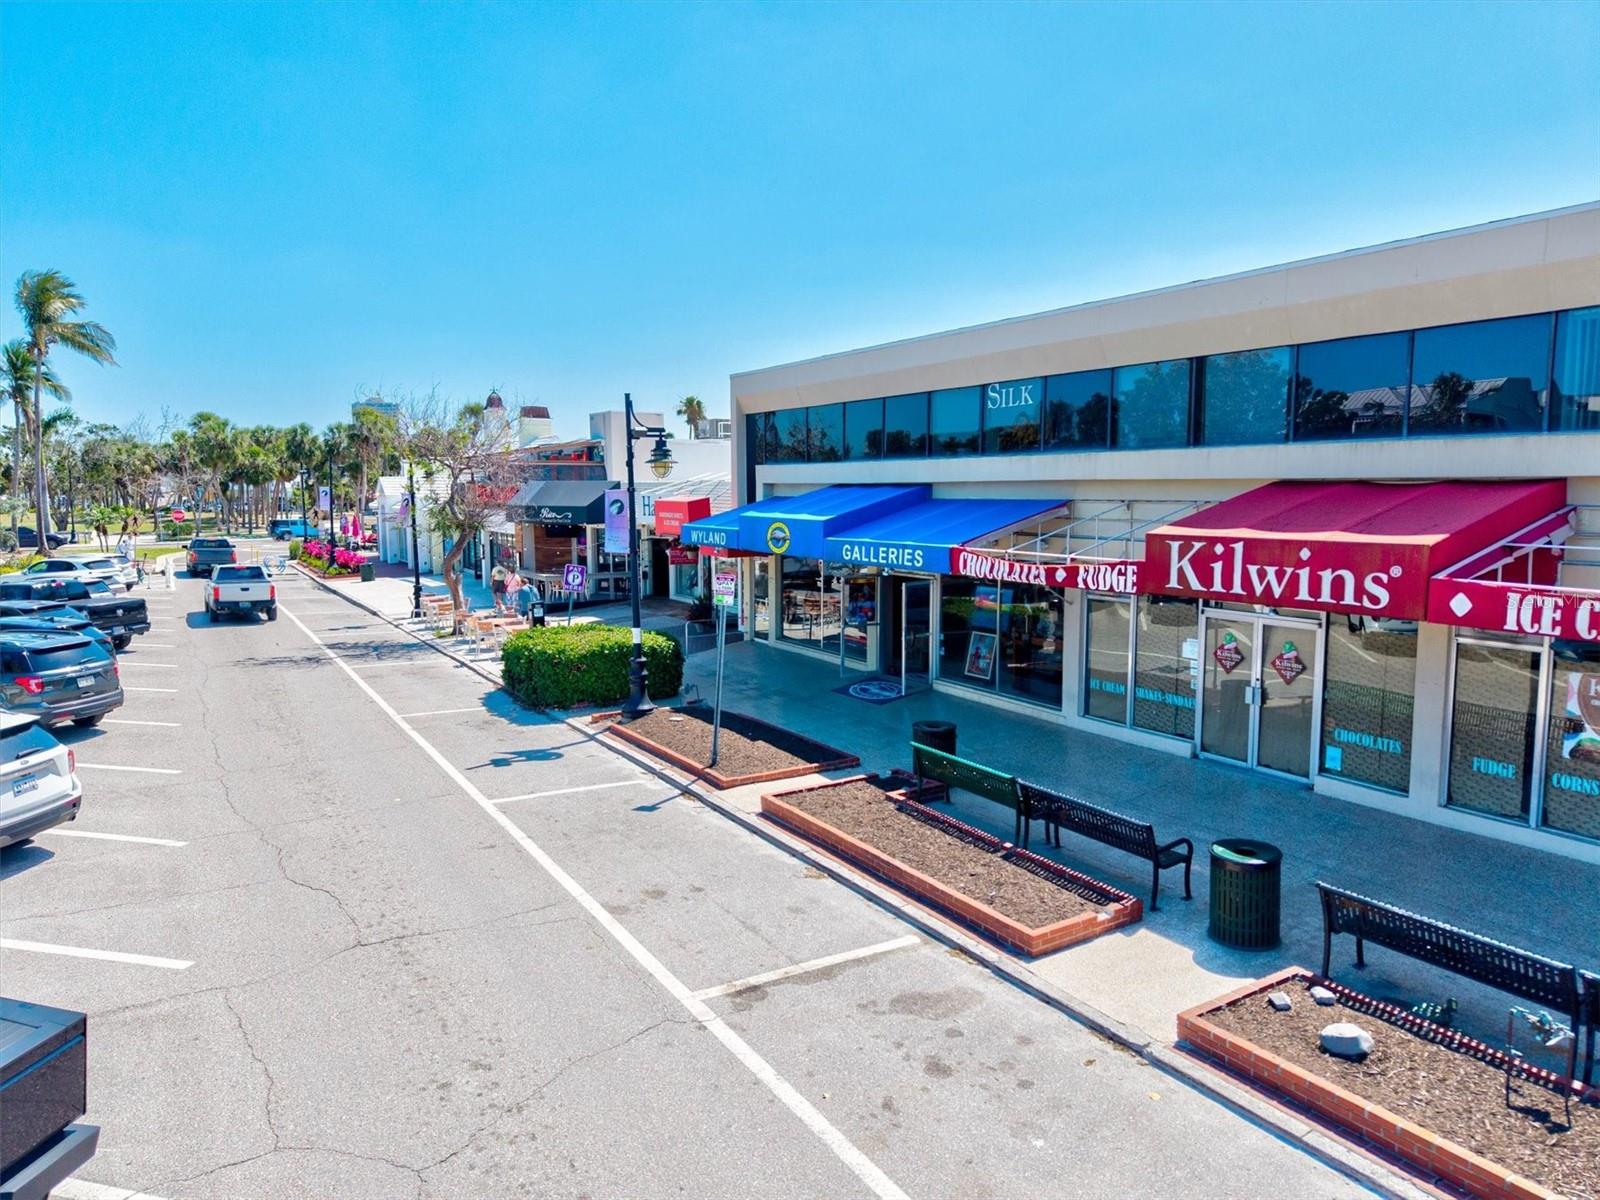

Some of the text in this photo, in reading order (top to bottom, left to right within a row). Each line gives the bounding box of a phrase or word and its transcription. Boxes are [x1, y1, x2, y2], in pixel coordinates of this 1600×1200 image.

[690, 530, 923, 568] WYLAND GALLERIES
[1076, 564, 1138, 593] FUDGE
[1503, 592, 1600, 640] ICE C
[1216, 649, 1241, 659] Kilwins
[1275, 658, 1303, 669] Kilwins
[1334, 728, 1403, 753] CHOCOLATES
[1472, 757, 1517, 780] FUDGE
[1552, 772, 1600, 796] CORNS
